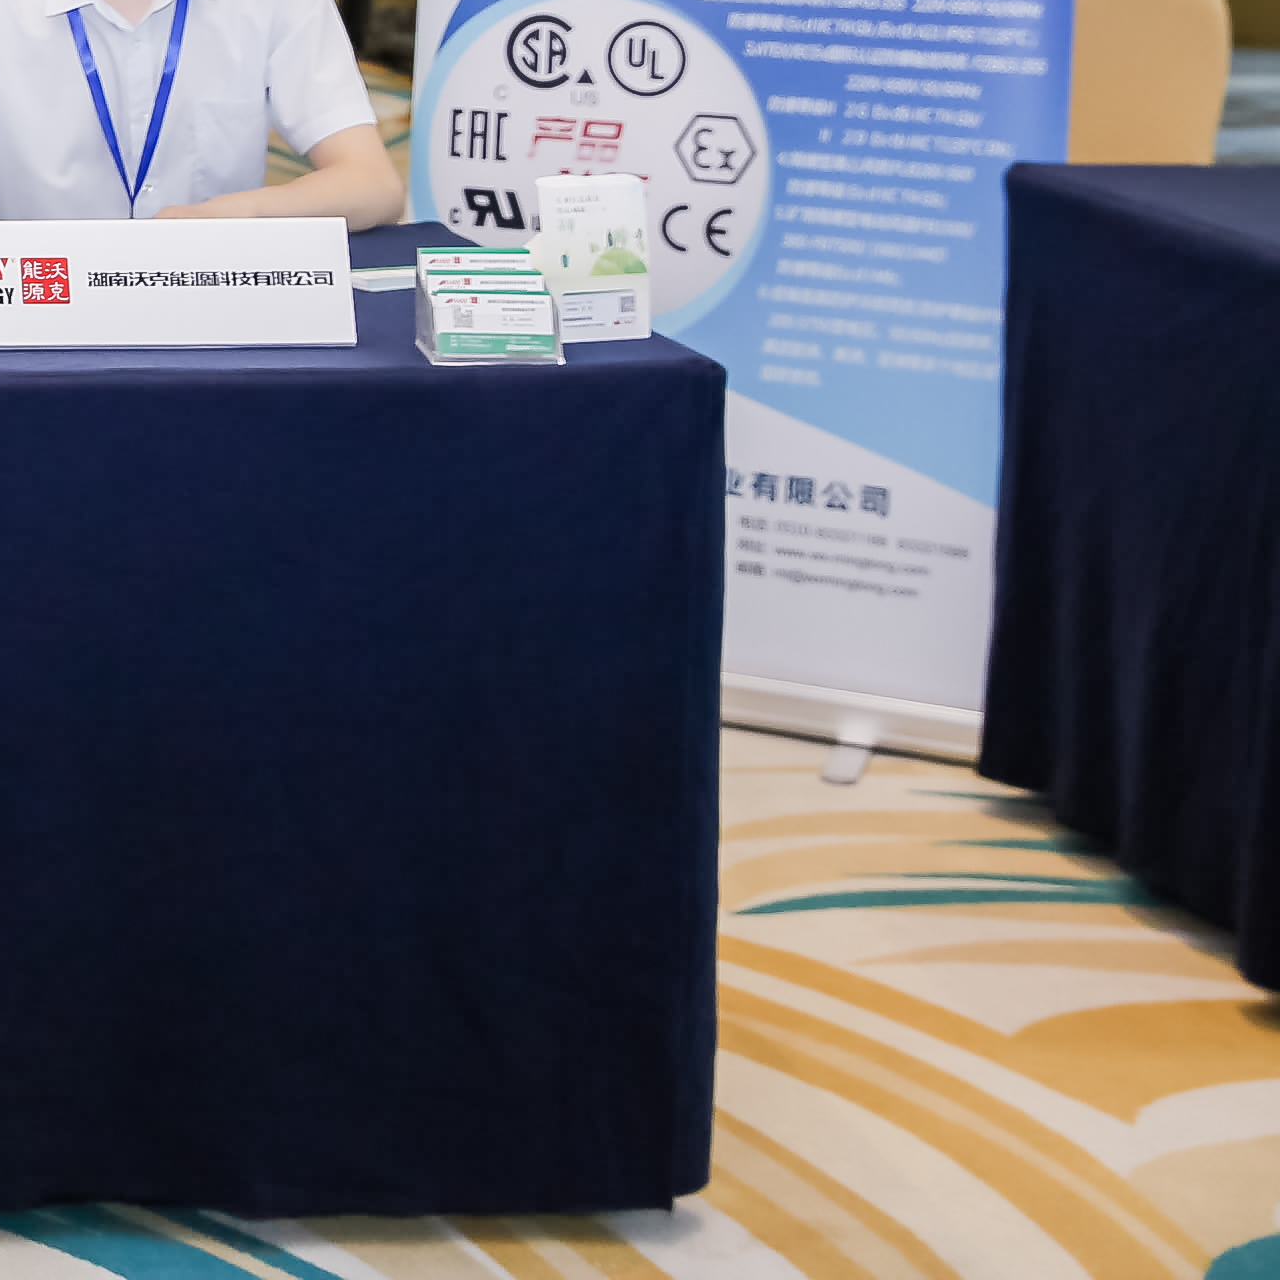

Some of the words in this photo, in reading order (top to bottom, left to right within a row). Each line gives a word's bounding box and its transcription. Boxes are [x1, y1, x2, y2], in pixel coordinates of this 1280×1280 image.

[628, 38, 665, 79] UL
[450, 109, 509, 160] EAC
[528, 117, 623, 163] 产品
[662, 205, 732, 256] CE
[87, 270, 335, 287] 湖南沃克能源科技有限公司
